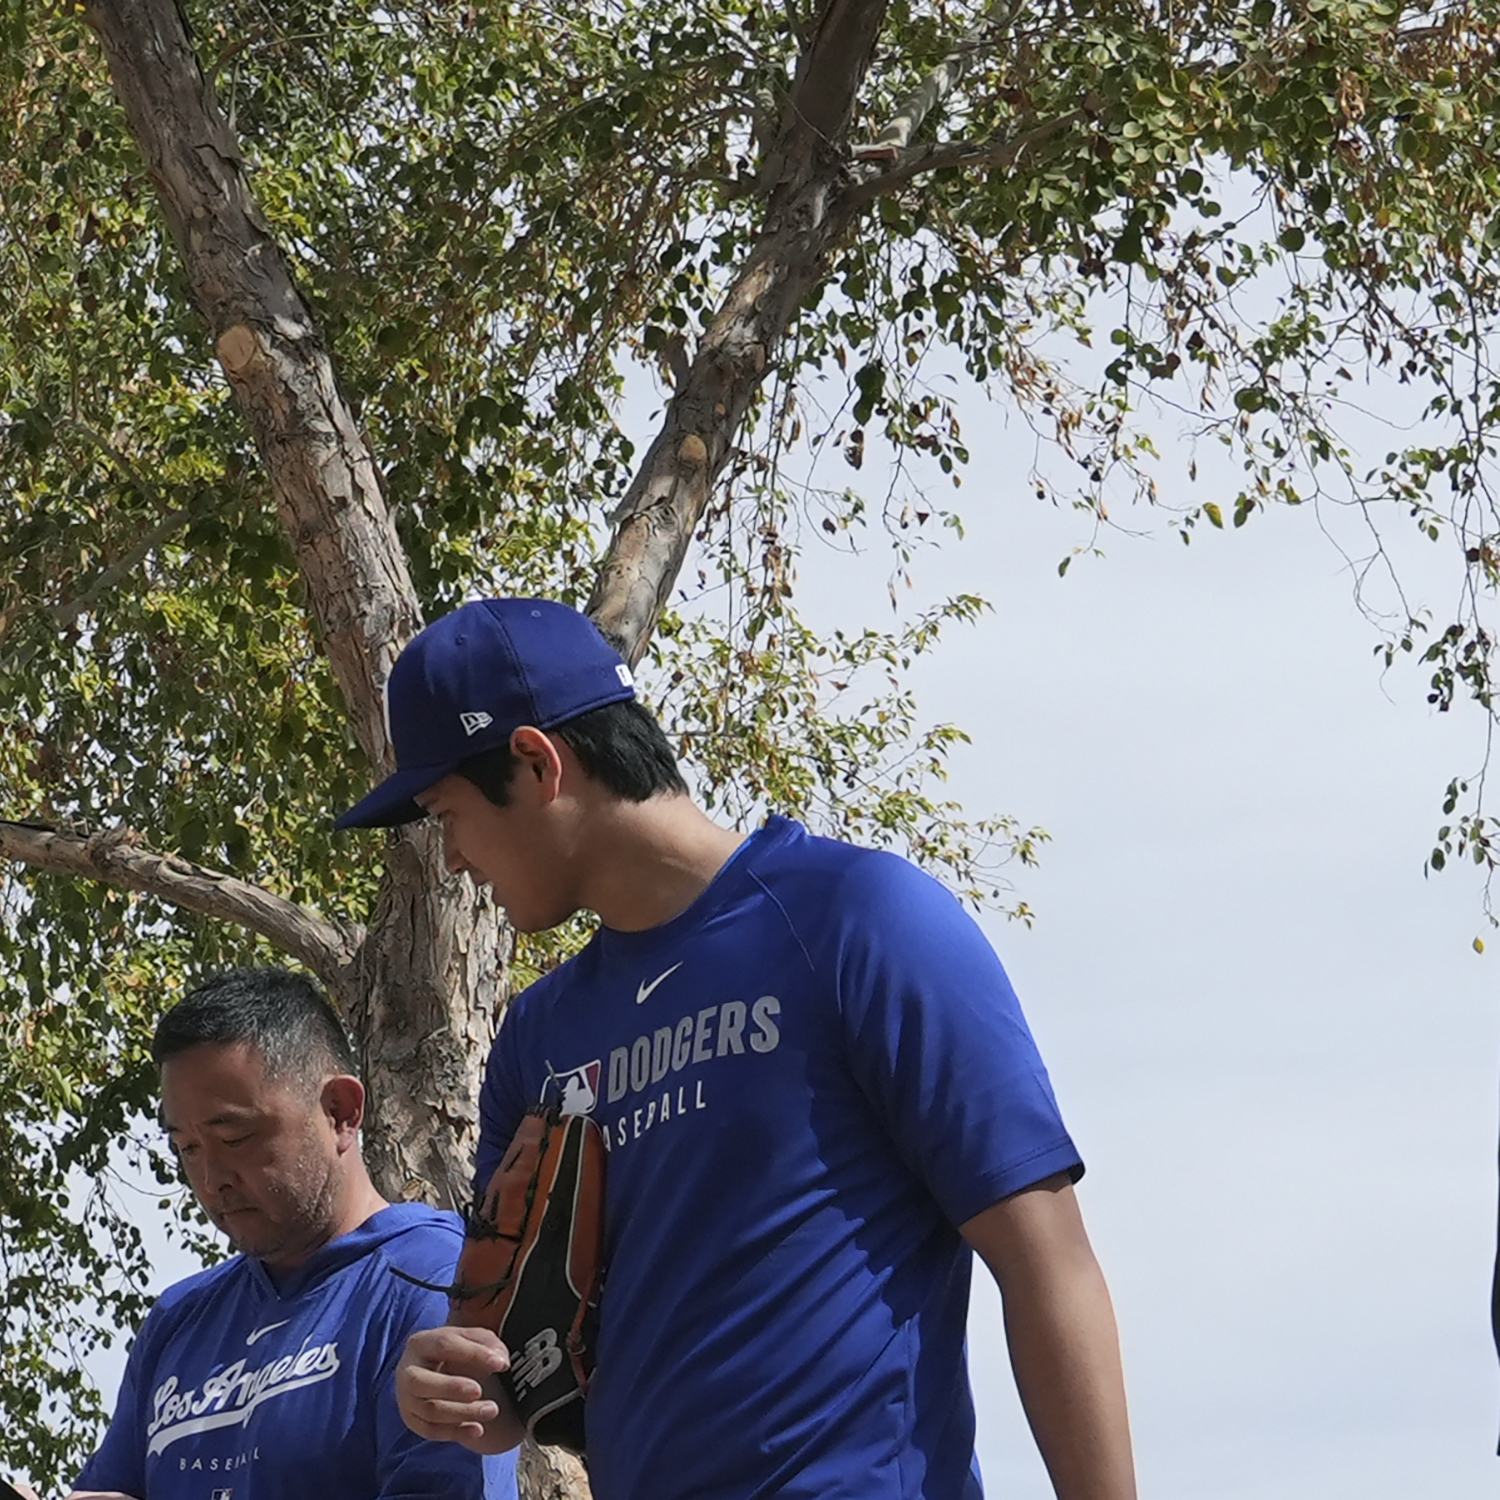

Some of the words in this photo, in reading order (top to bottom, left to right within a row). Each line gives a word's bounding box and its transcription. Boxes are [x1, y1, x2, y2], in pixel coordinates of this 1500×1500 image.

[608, 995, 781, 1104] DODGERS
[602, 1080, 706, 1152] ASEBALL
[147, 1375, 196, 1437] Los
[192, 1333, 340, 1426] Angeles
